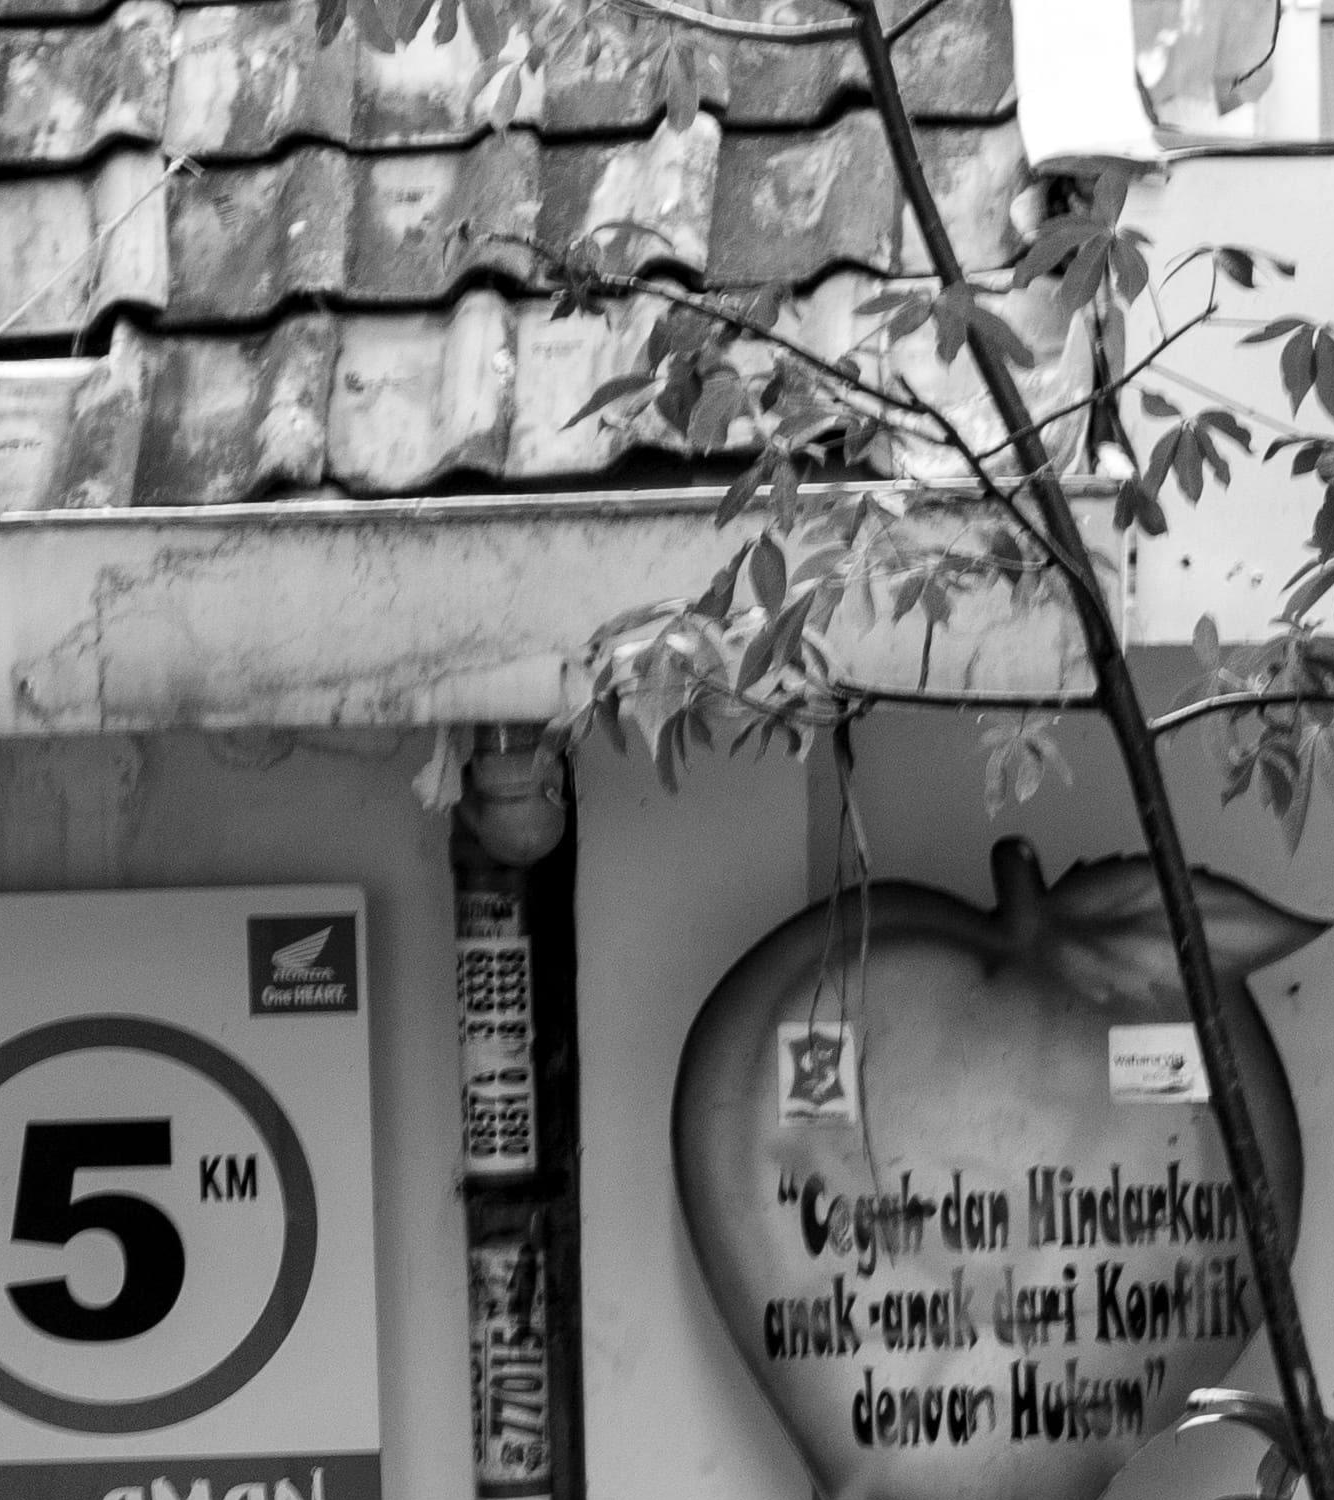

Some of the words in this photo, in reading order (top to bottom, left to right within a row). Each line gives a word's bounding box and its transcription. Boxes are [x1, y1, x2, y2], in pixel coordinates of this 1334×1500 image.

[198, 1153, 258, 1201] KM
[940, 1169, 1009, 1254] dan
[1028, 1160, 1237, 1249] Hindarkan
[5, 1116, 185, 1342] 5
[993, 1263, 1077, 1347] dari
[1095, 1254, 1250, 1342] Konflik
